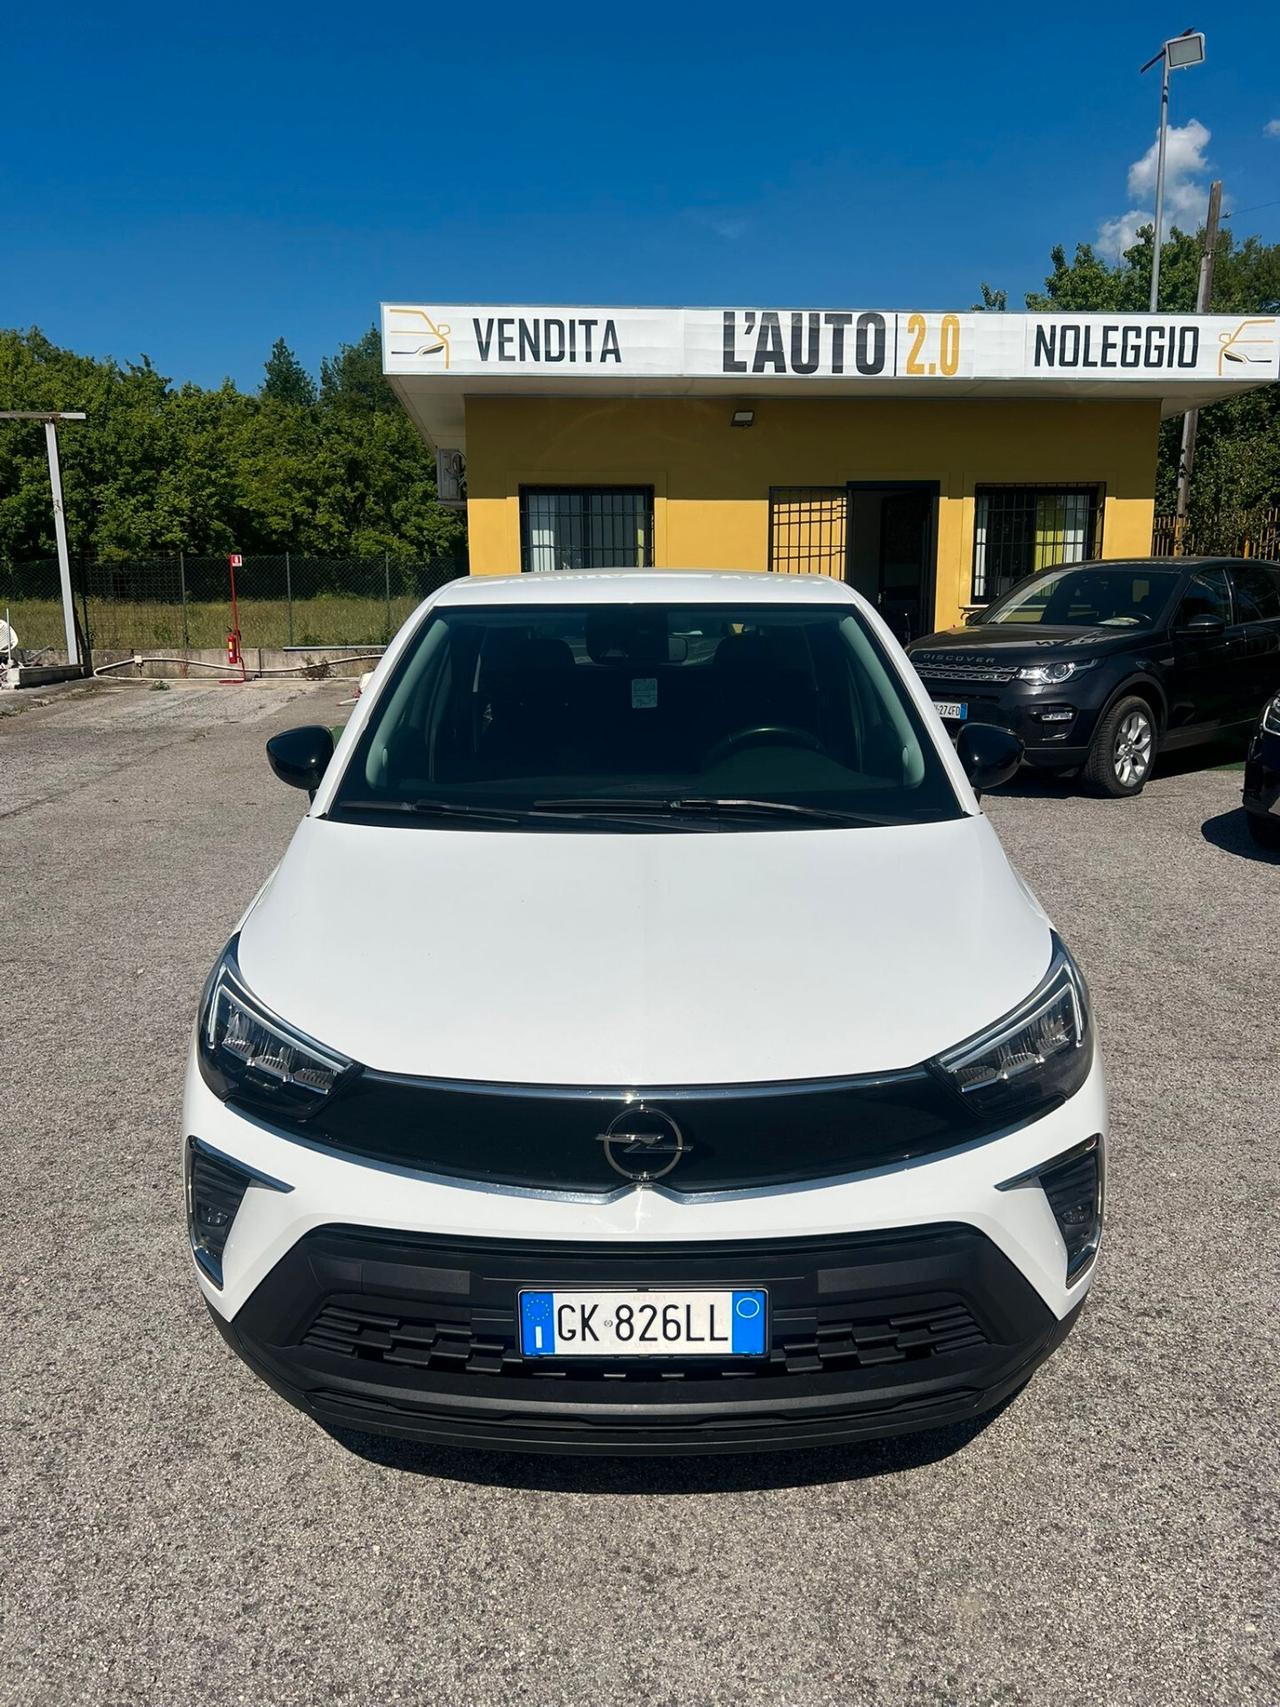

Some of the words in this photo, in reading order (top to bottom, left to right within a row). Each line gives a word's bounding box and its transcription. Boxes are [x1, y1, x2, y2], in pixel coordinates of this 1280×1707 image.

[472, 318, 622, 363] VENDITA
[722, 311, 887, 376] L'AUTO
[906, 312, 961, 377] 2.0
[1034, 324, 1200, 369] NOLEGGIO
[557, 1303, 600, 1342] GK
[614, 1303, 729, 1342] 826LL
